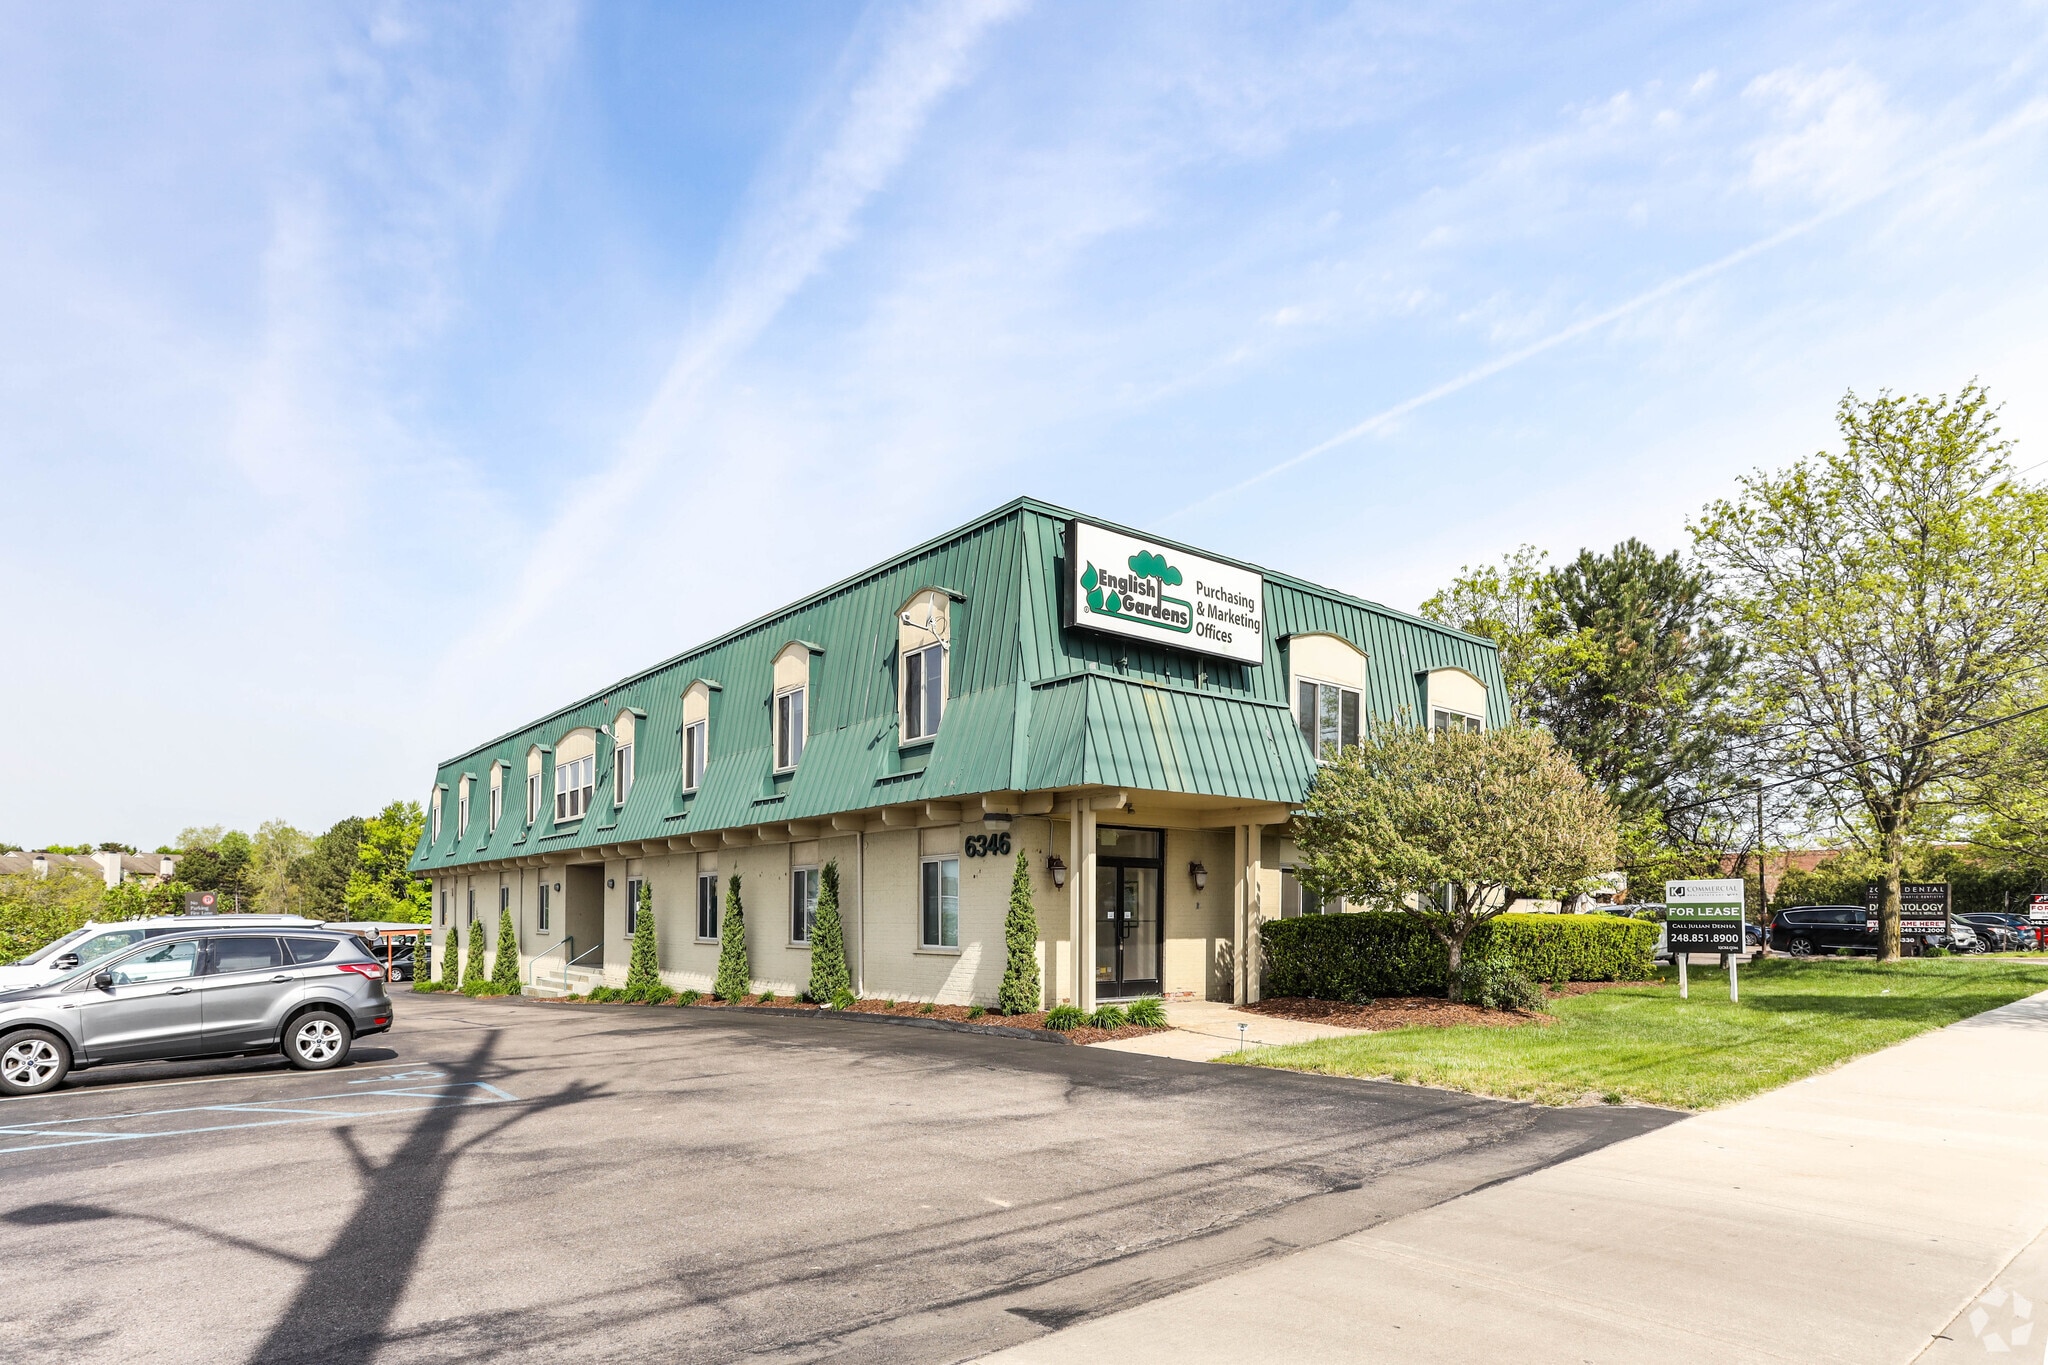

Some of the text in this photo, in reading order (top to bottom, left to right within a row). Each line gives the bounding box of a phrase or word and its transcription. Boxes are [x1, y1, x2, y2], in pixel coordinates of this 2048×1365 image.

[1098, 568, 1156, 598] English
[1196, 580, 1255, 613] Purchasing
[1122, 594, 1188, 625] Gardens
[1196, 601, 1261, 635] & Marketing
[1196, 622, 1233, 644] Offices
[965, 832, 1011, 858] 6346
[1669, 907, 1740, 916] FOR LEASE
[1670, 933, 1739, 943] 248.851.8900
